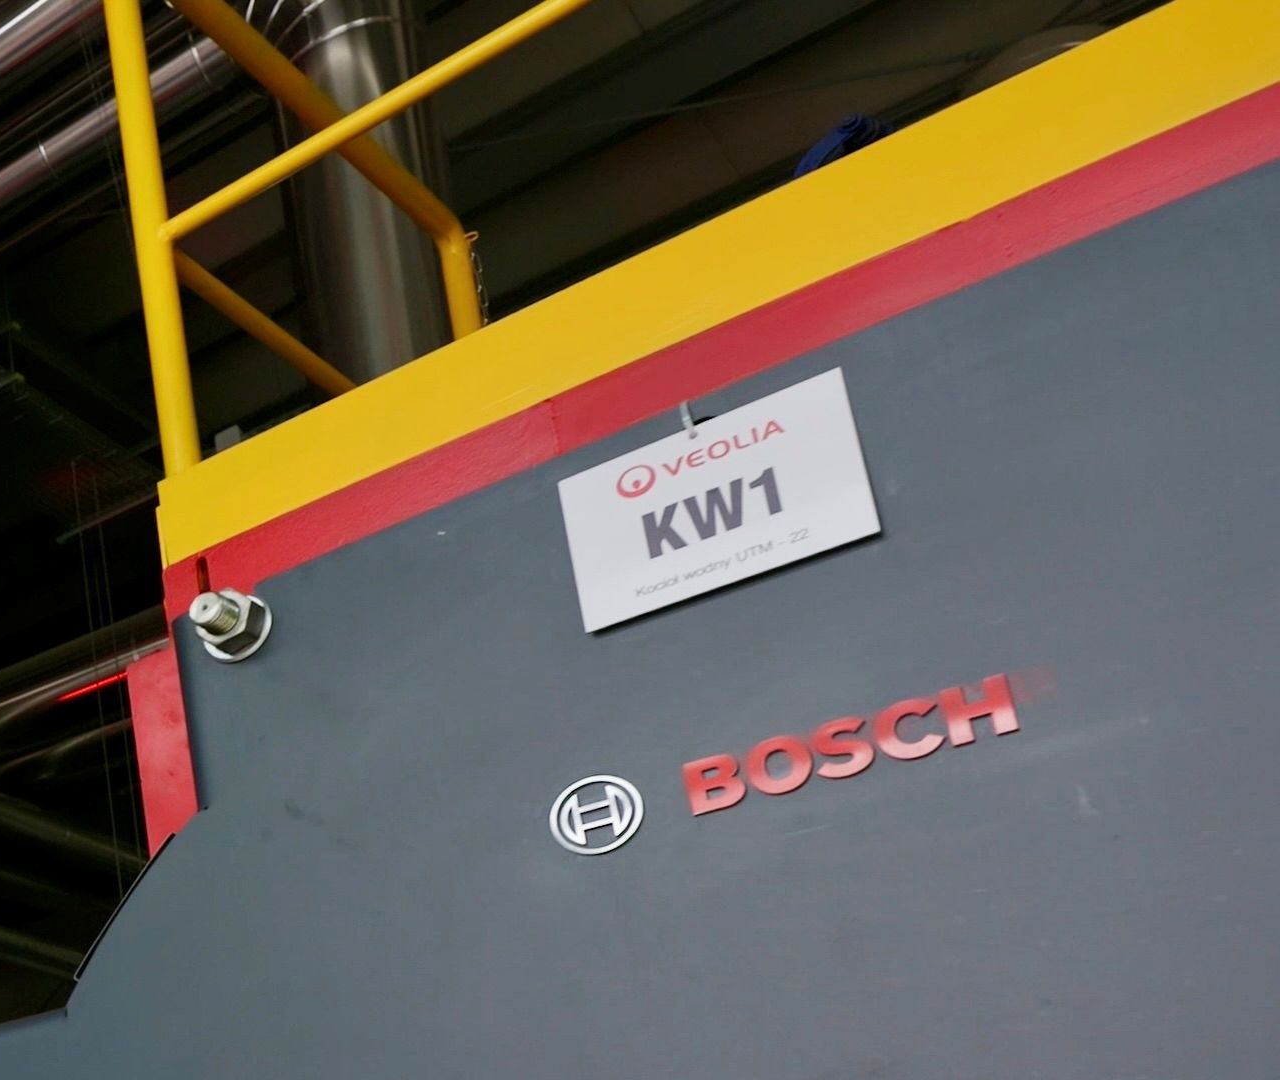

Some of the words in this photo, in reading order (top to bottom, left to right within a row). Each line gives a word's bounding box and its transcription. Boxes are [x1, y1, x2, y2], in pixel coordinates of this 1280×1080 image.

[662, 419, 786, 477] VEOLIA
[641, 466, 783, 559] KW1
[684, 556, 732, 581] wodny
[735, 540, 774, 562] UTM
[790, 528, 809, 545] 22
[682, 672, 1020, 816] BOSCH
